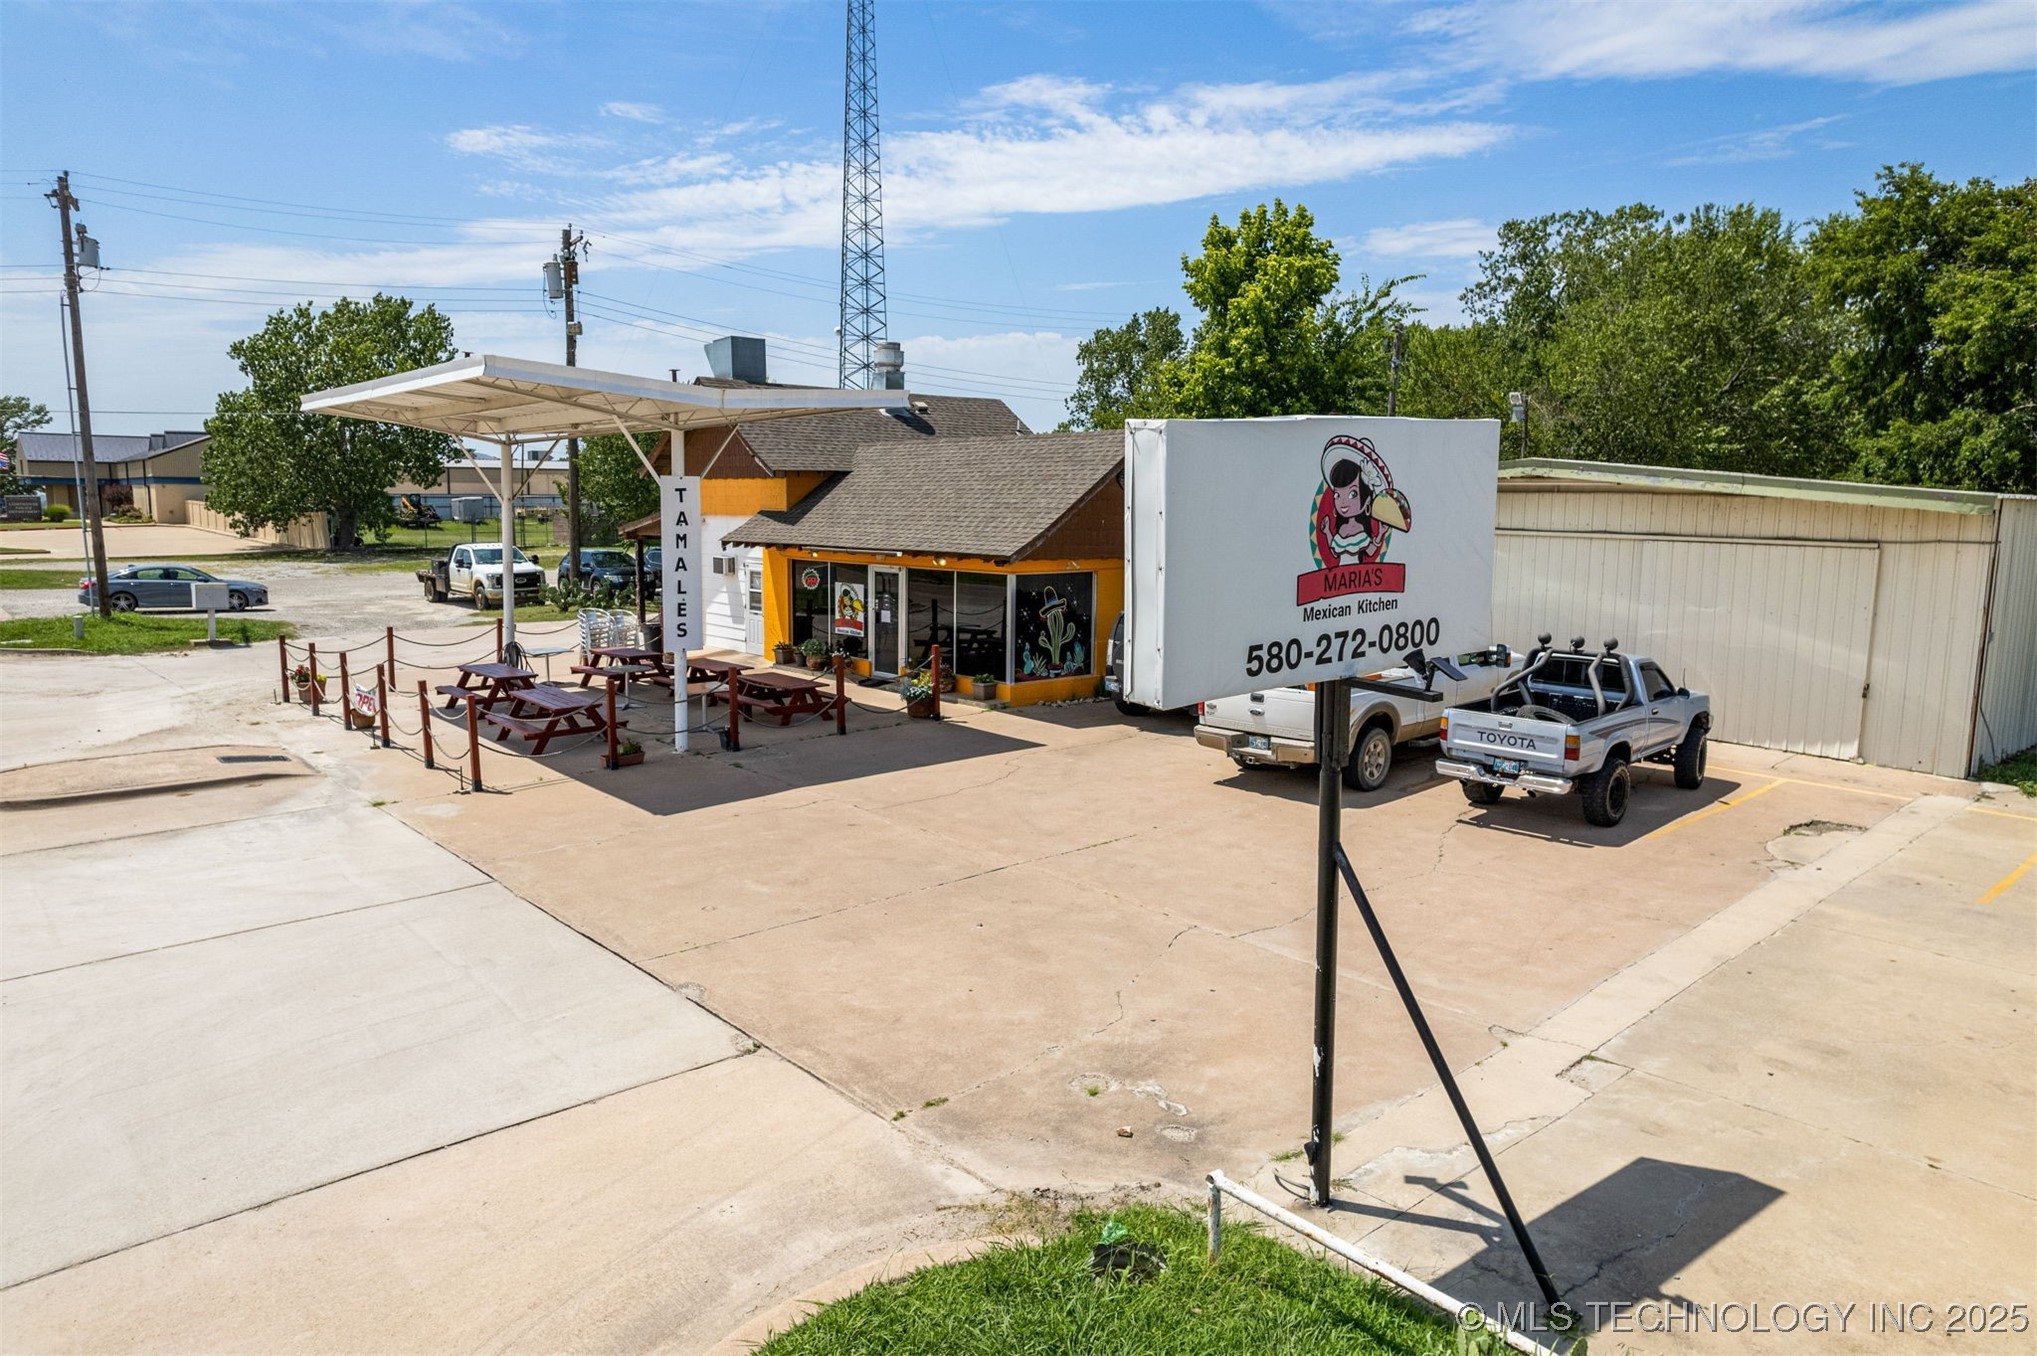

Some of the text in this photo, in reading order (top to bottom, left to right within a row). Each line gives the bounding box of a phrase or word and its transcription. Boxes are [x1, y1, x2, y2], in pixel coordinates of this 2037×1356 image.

[674, 488, 689, 638] TAMALES
[1324, 567, 1383, 593] MARIA'S
[1303, 597, 1398, 622] Mexican Kitchen
[1246, 617, 1440, 677] 580-272-0800
[1477, 731, 1537, 750] TOYOTA
